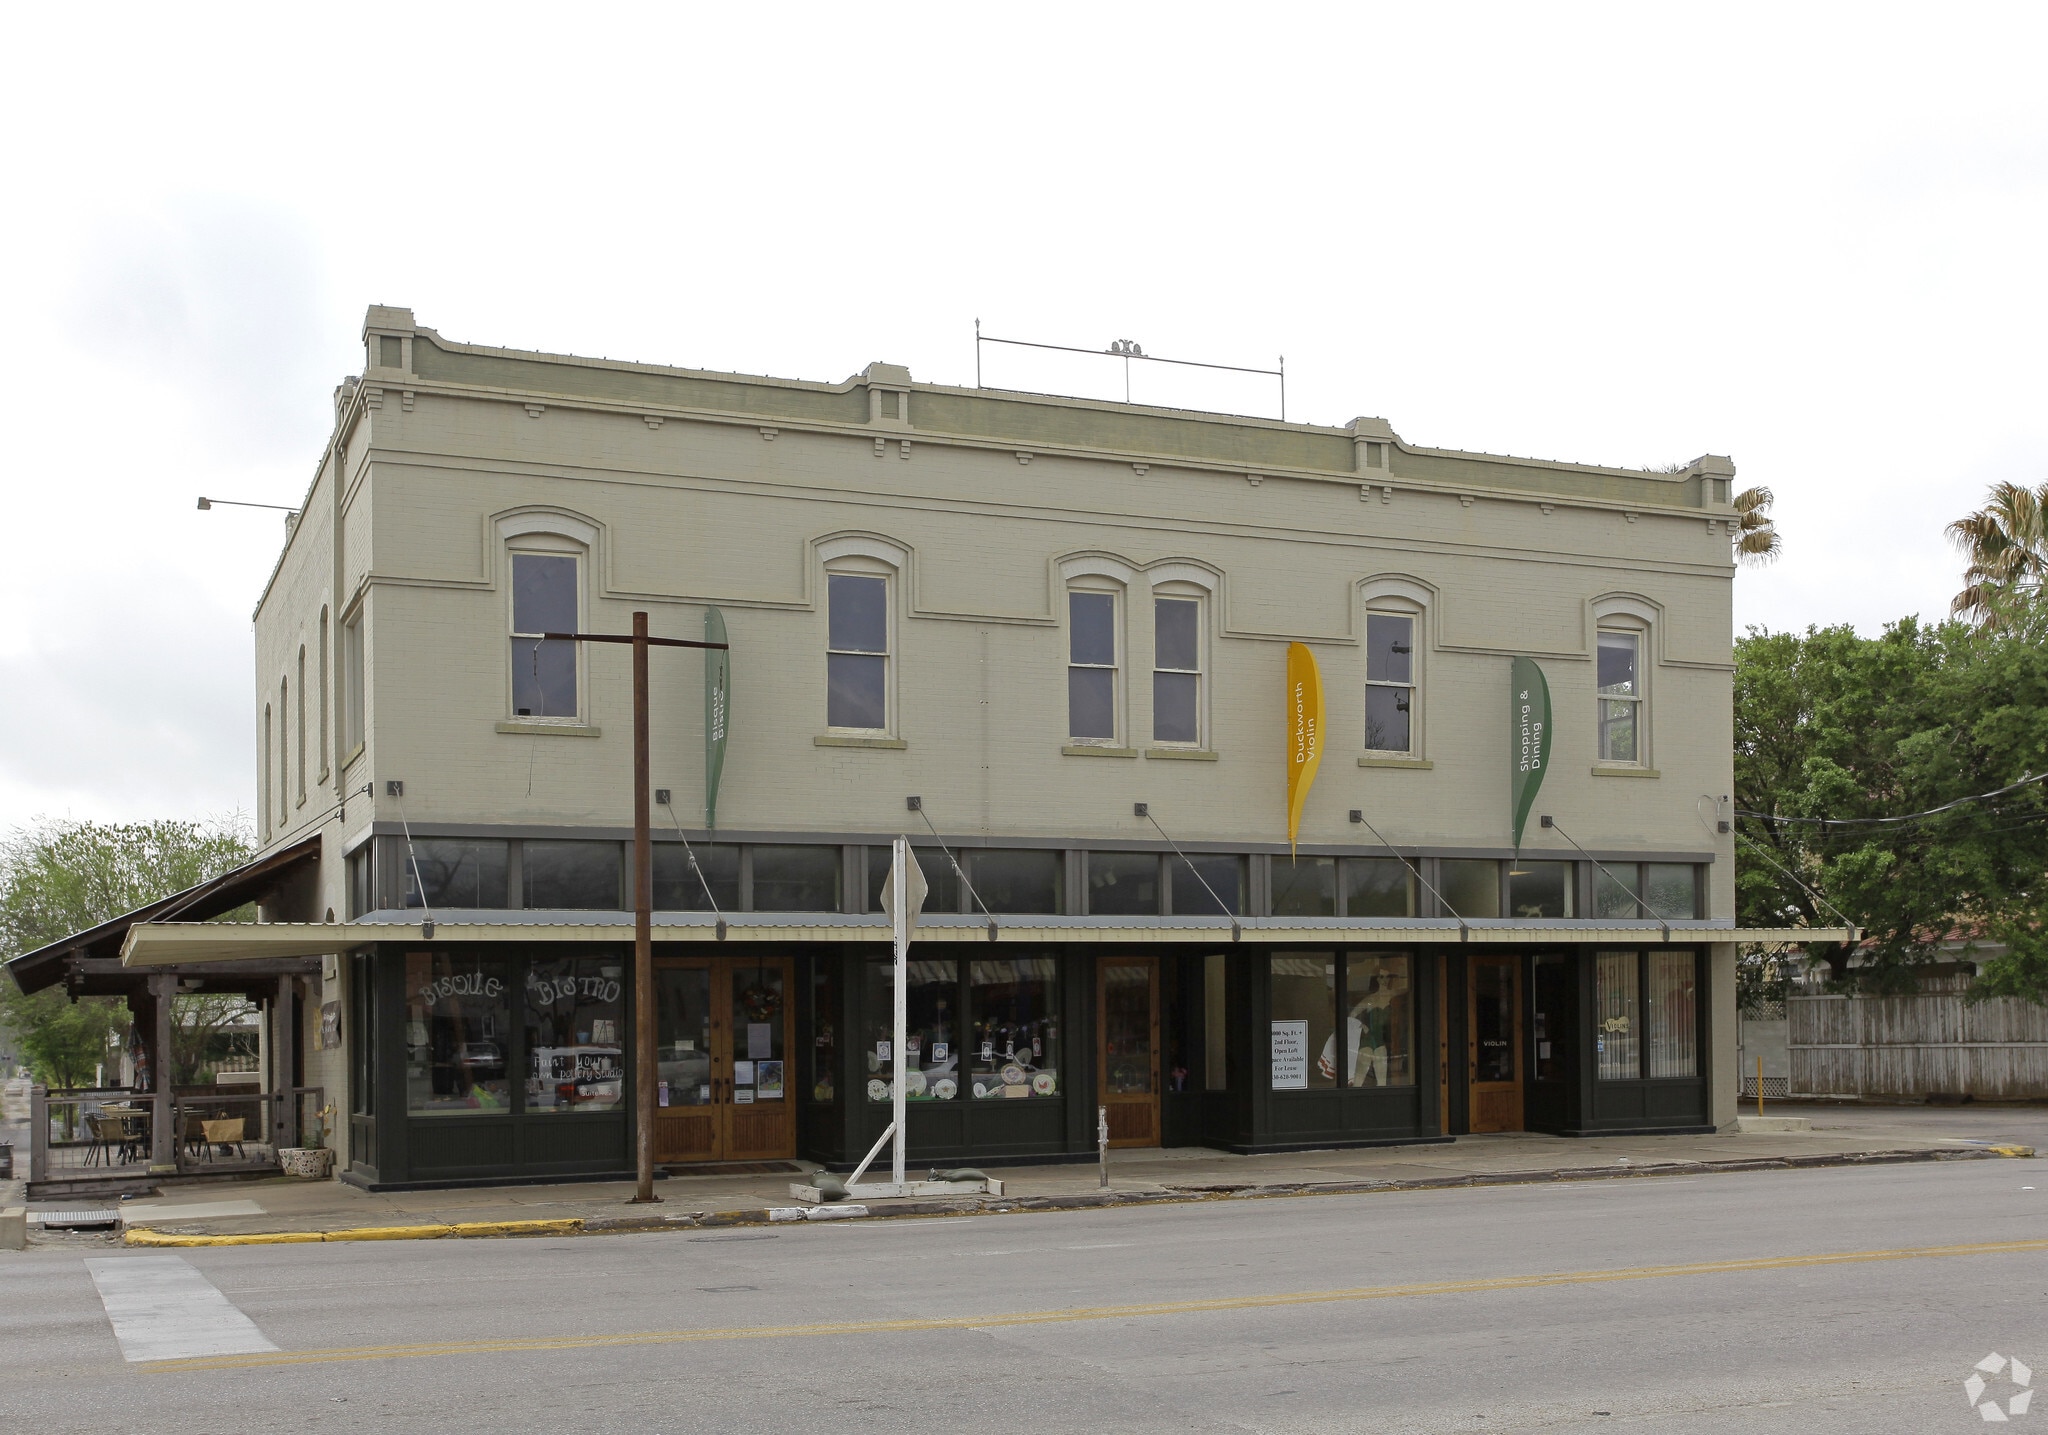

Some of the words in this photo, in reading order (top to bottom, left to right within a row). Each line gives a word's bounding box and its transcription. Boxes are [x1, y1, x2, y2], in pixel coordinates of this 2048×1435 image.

[1520, 690, 1528, 700] &
[1295, 682, 1304, 763] Duckworth
[1307, 718, 1315, 762] Violin
[1520, 705, 1530, 772] Shopping
[1532, 722, 1542, 769] Dining
[535, 976, 621, 1006] BISTRO
[534, 1057, 564, 1067] Paint
